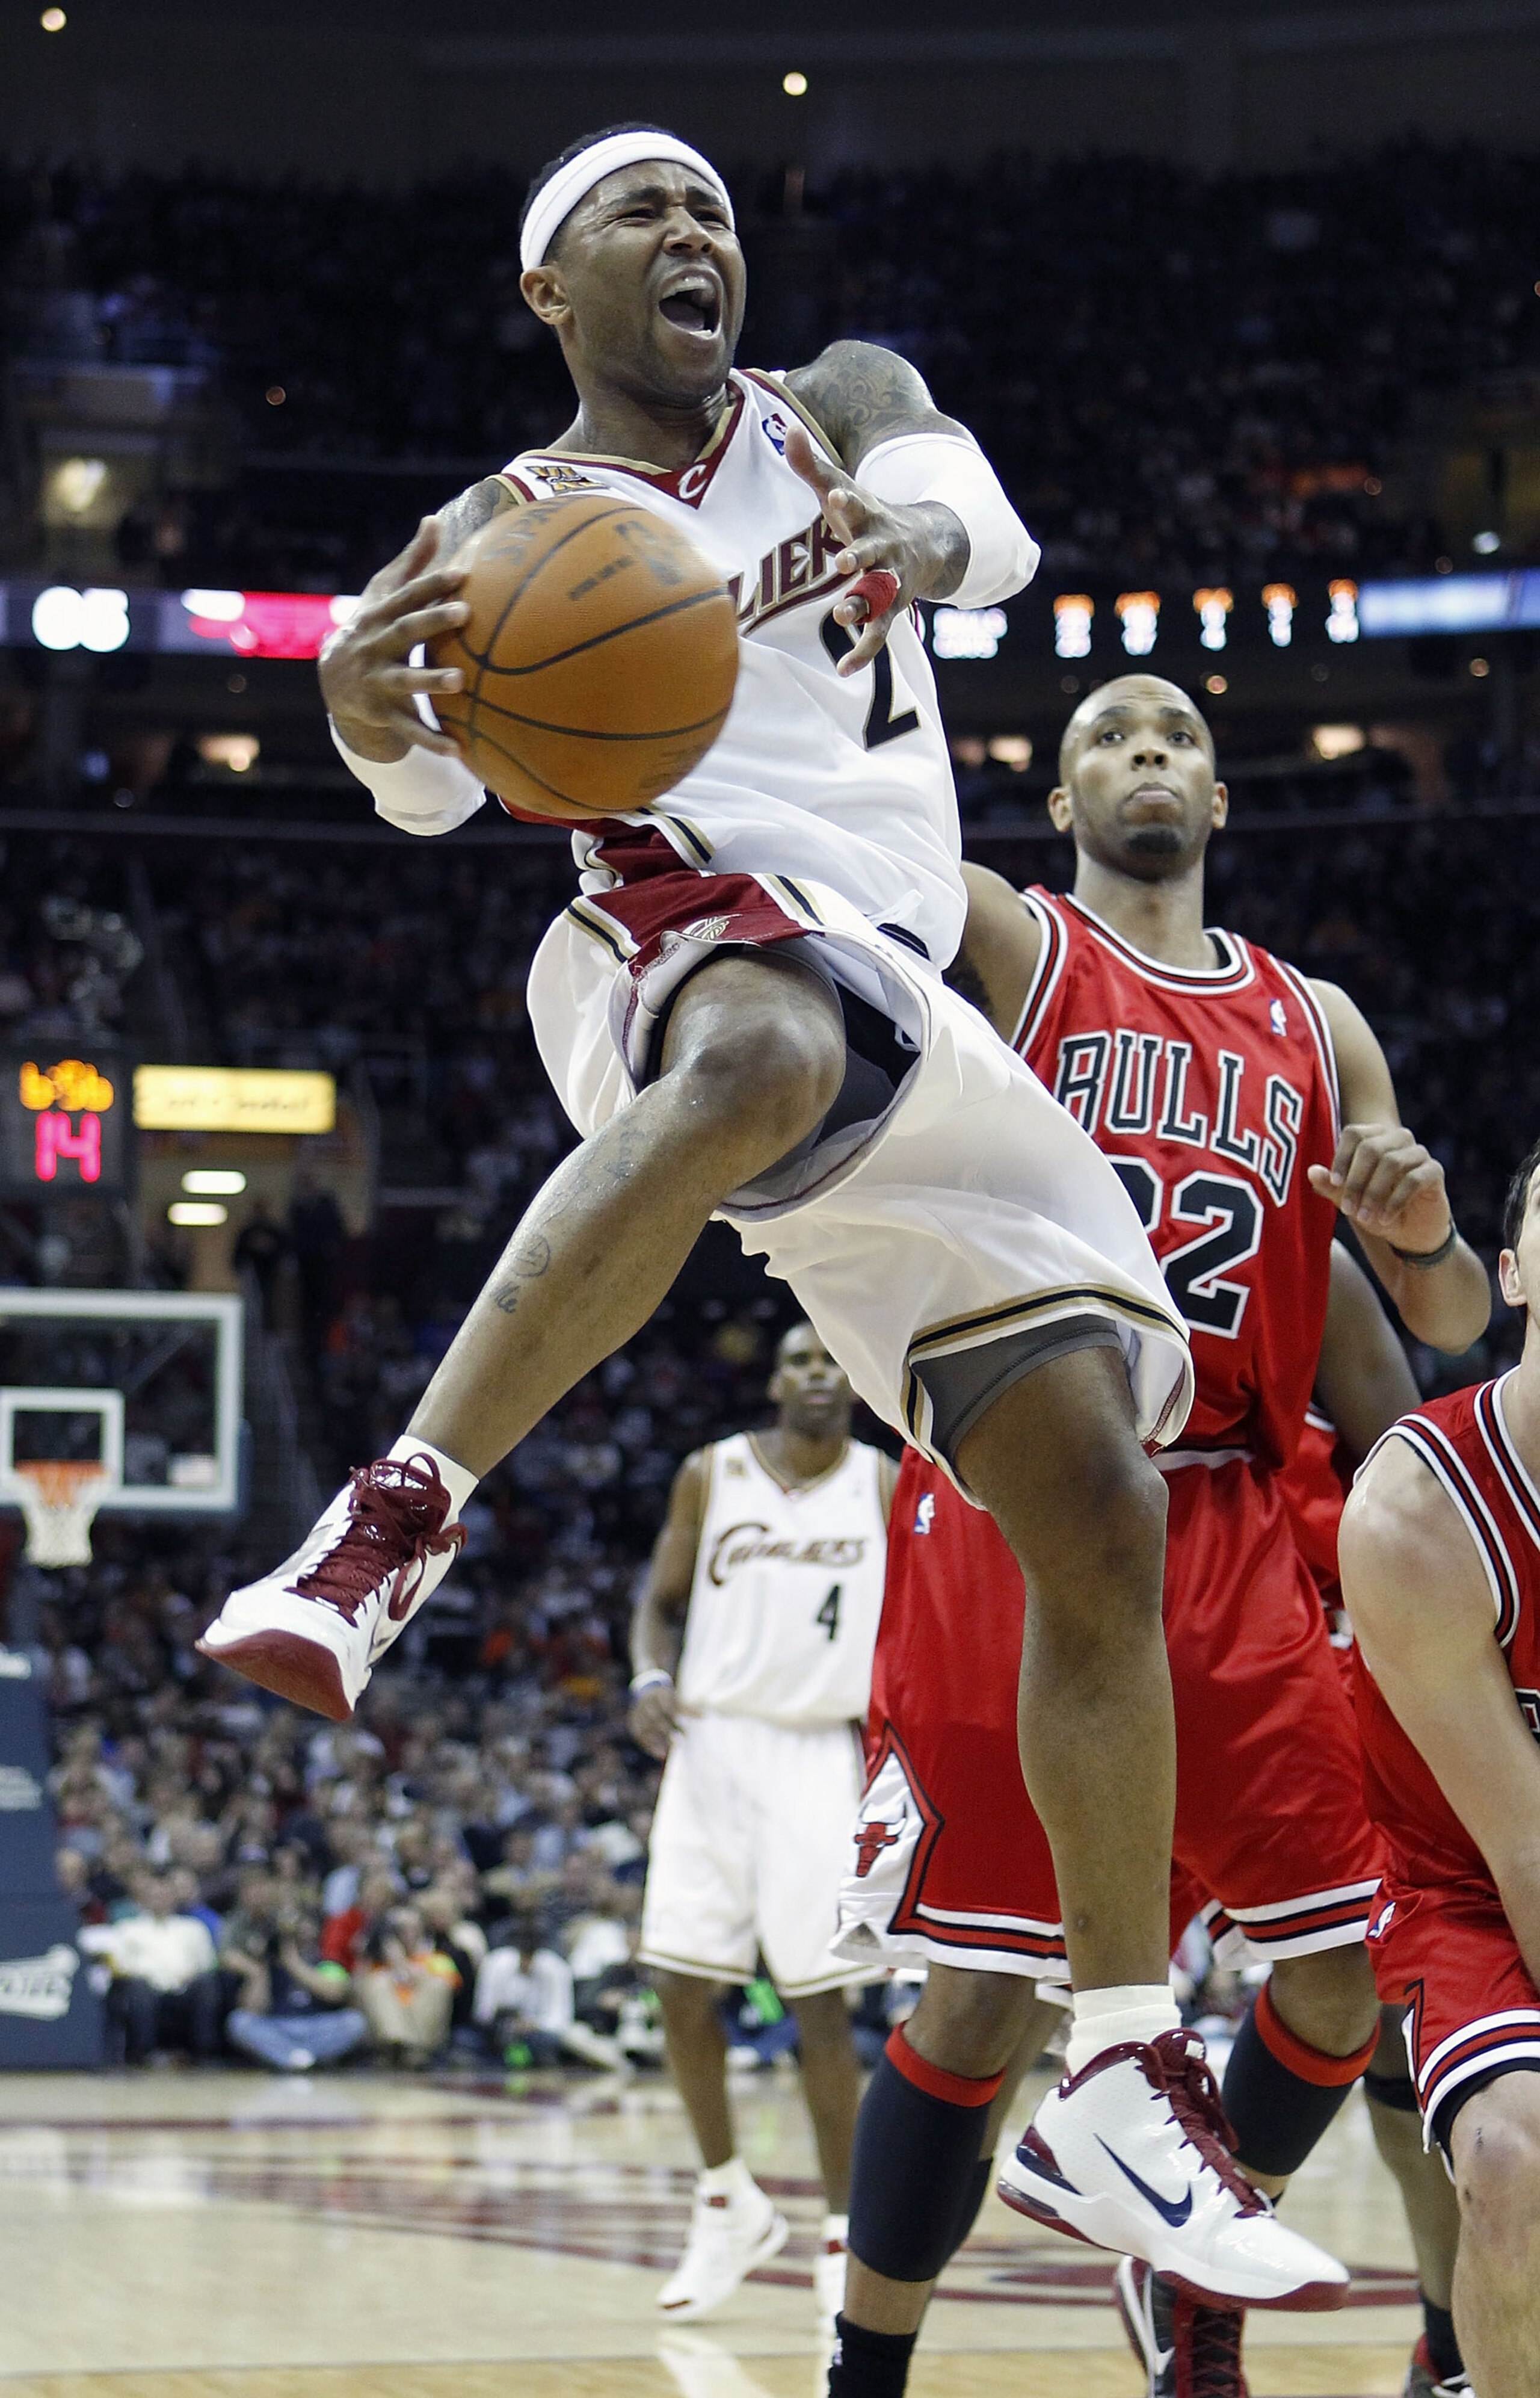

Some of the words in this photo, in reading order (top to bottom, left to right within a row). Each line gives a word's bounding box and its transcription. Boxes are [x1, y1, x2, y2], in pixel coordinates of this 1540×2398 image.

[678, 464, 706, 499] C
[727, 511, 848, 626] LIER
[35, 1111, 101, 1182] 14
[1054, 1027, 1304, 1208] BULLS
[816, 1583, 842, 1643] 4
